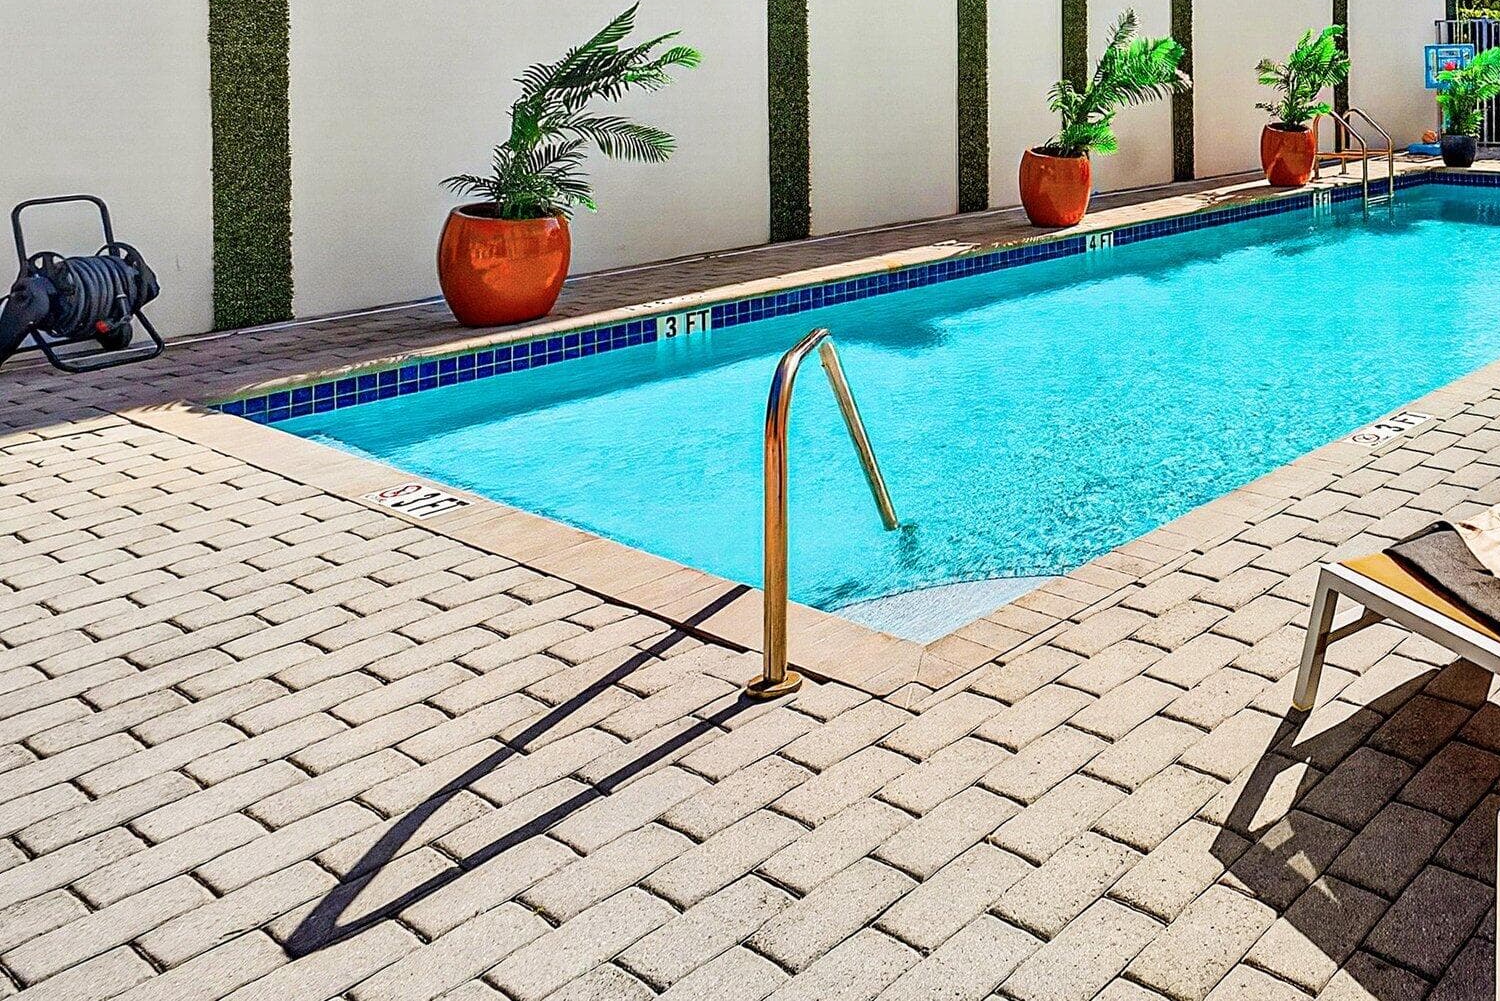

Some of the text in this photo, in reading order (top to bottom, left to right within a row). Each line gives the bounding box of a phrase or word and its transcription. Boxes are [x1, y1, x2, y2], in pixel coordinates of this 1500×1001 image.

[1089, 232, 1113, 250] 4 FT
[666, 309, 710, 338] 3 FT
[1374, 411, 1427, 432] 3 FT
[391, 492, 441, 507] 3
[407, 497, 470, 517] FT
